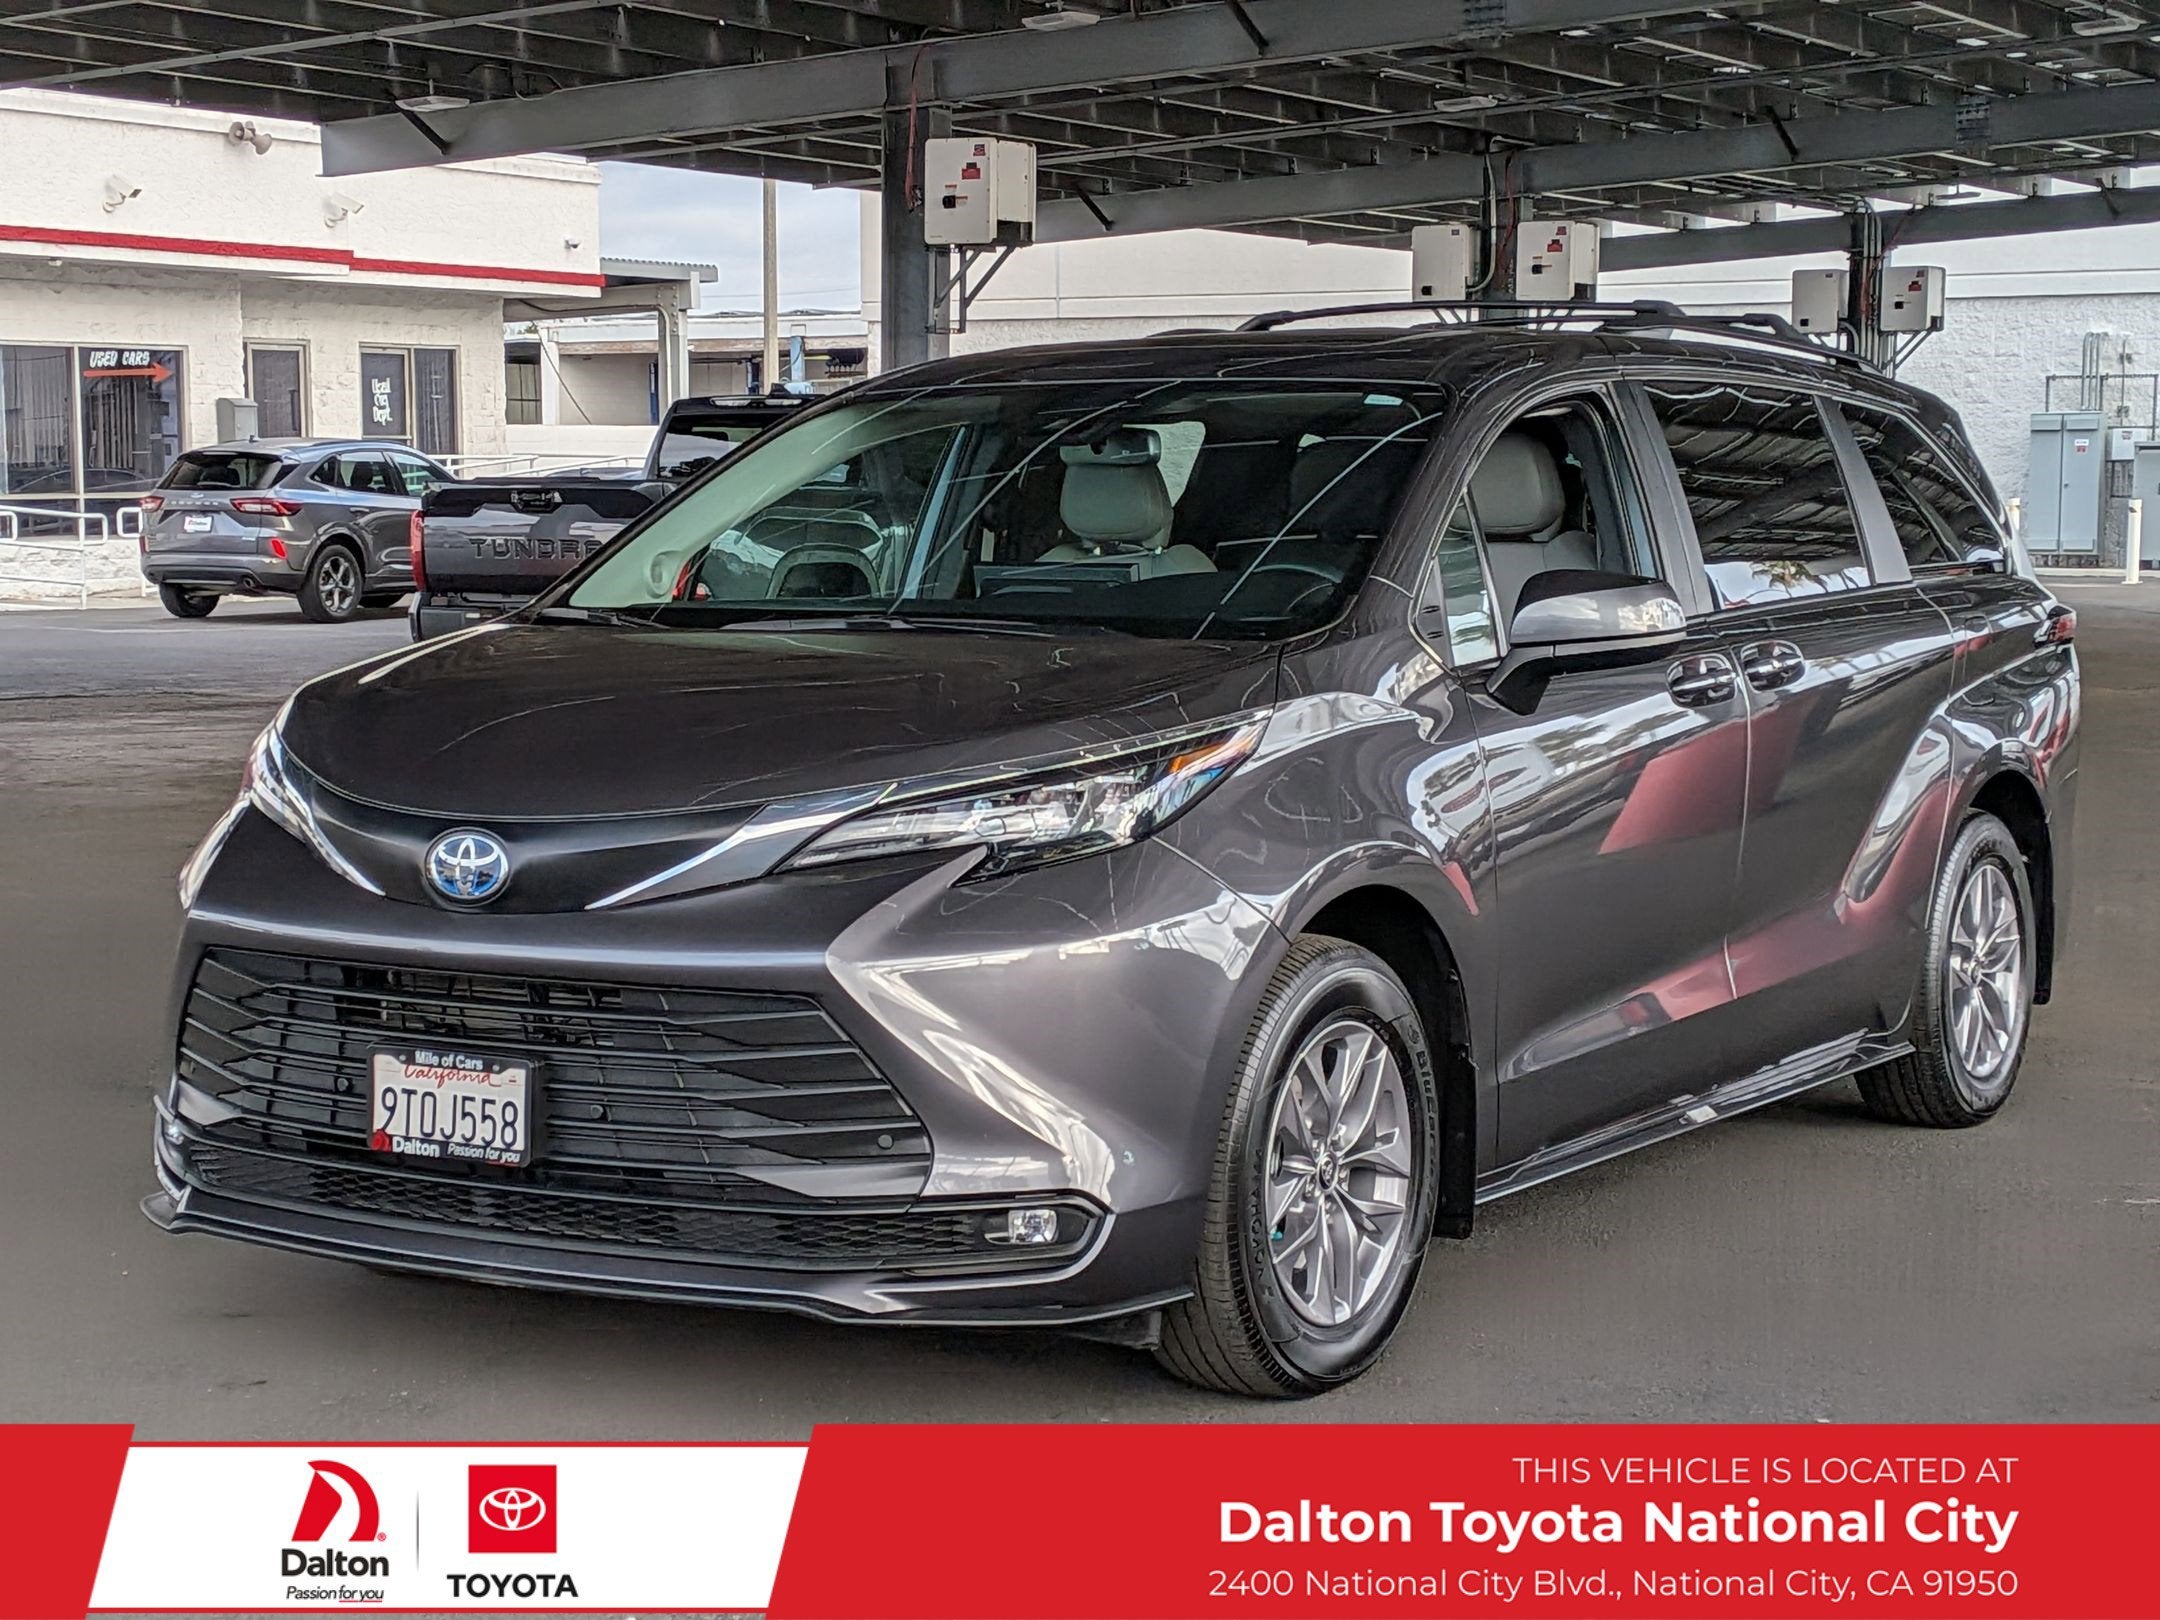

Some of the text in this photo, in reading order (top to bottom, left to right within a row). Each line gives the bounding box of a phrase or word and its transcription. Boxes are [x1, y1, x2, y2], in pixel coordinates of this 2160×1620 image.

[89, 350, 150, 368] USED CARS
[469, 538, 605, 560] TUNDRA
[415, 1050, 483, 1070] Mile of Cars
[404, 1063, 502, 1089] California
[392, 1136, 520, 1163] Dalton Passion for you
